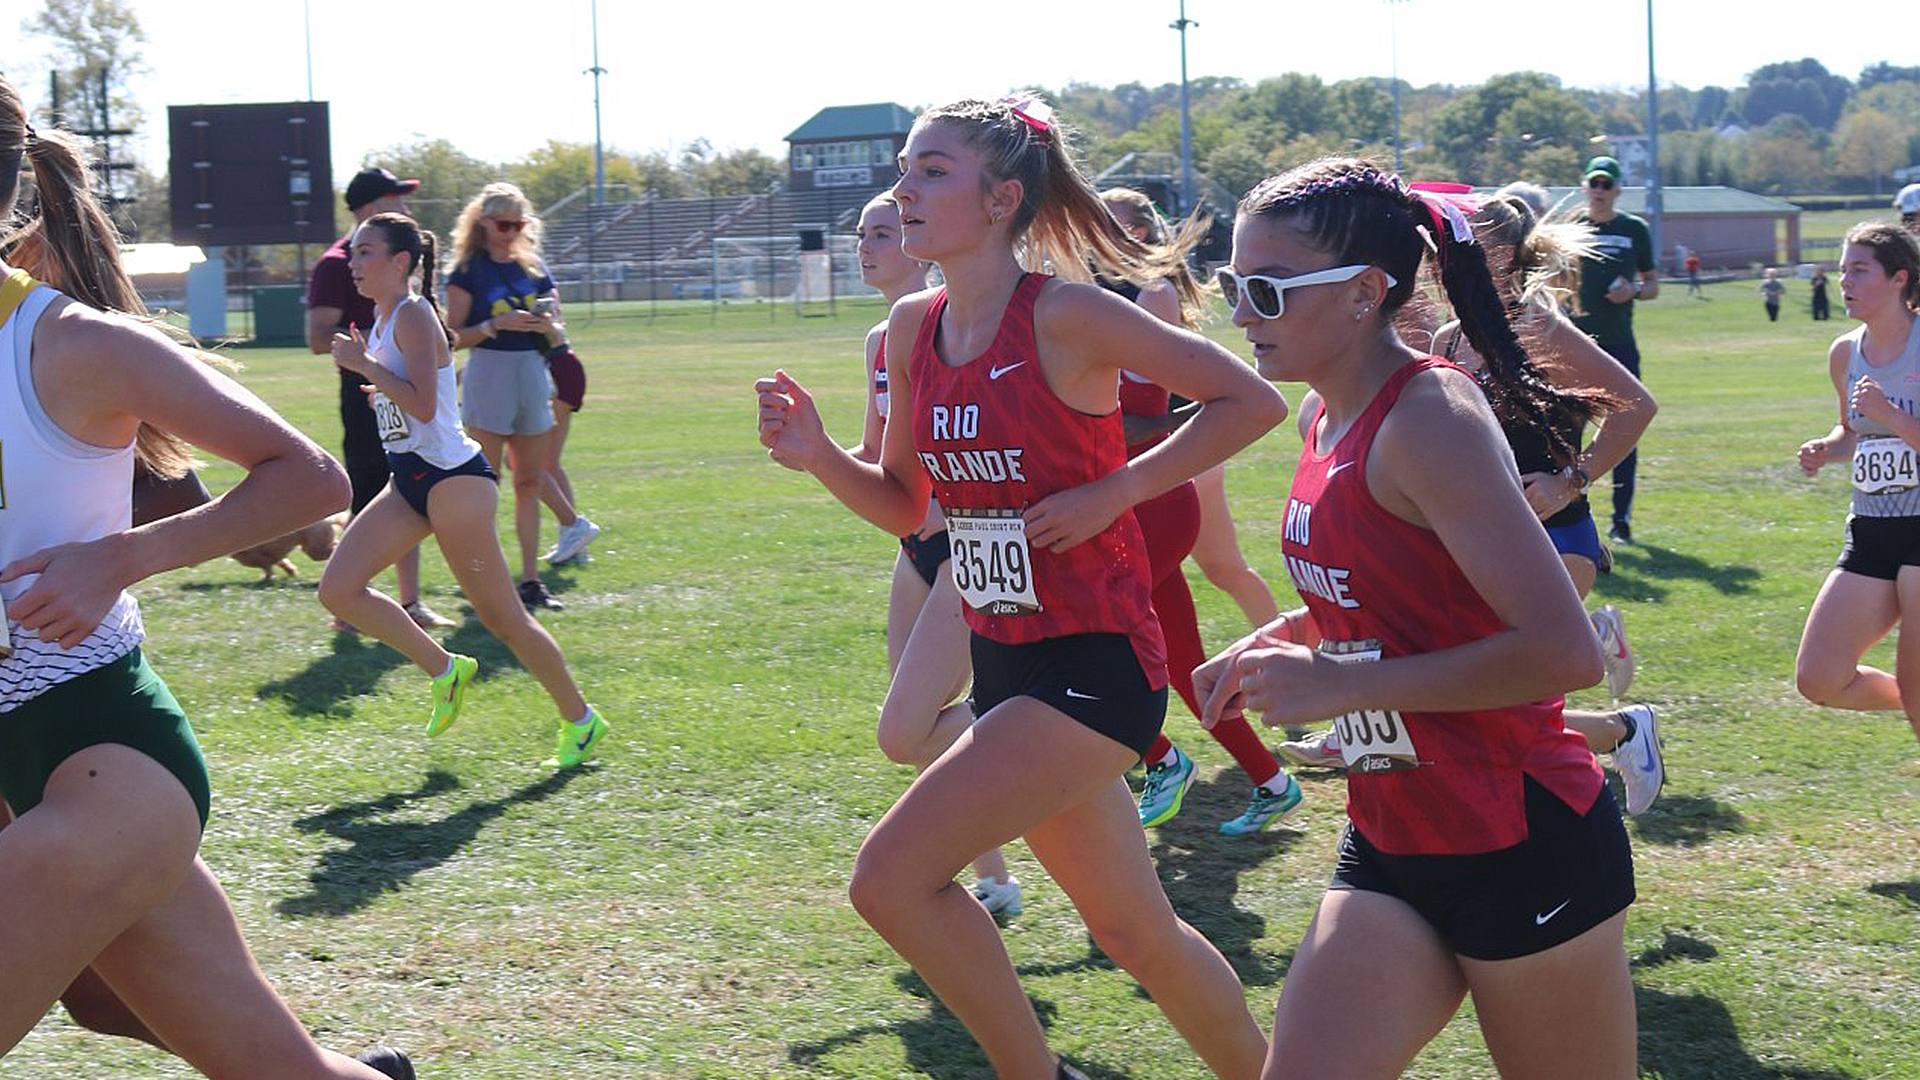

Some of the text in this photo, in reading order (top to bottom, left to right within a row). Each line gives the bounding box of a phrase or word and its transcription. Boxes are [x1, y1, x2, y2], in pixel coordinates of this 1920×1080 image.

[932, 404, 979, 441] RIO
[917, 449, 1027, 483] RANDE
[1855, 451, 1914, 483] 3634
[1285, 498, 1312, 547] RIO
[954, 539, 1027, 594] 3549
[1282, 554, 1361, 609] ANDE
